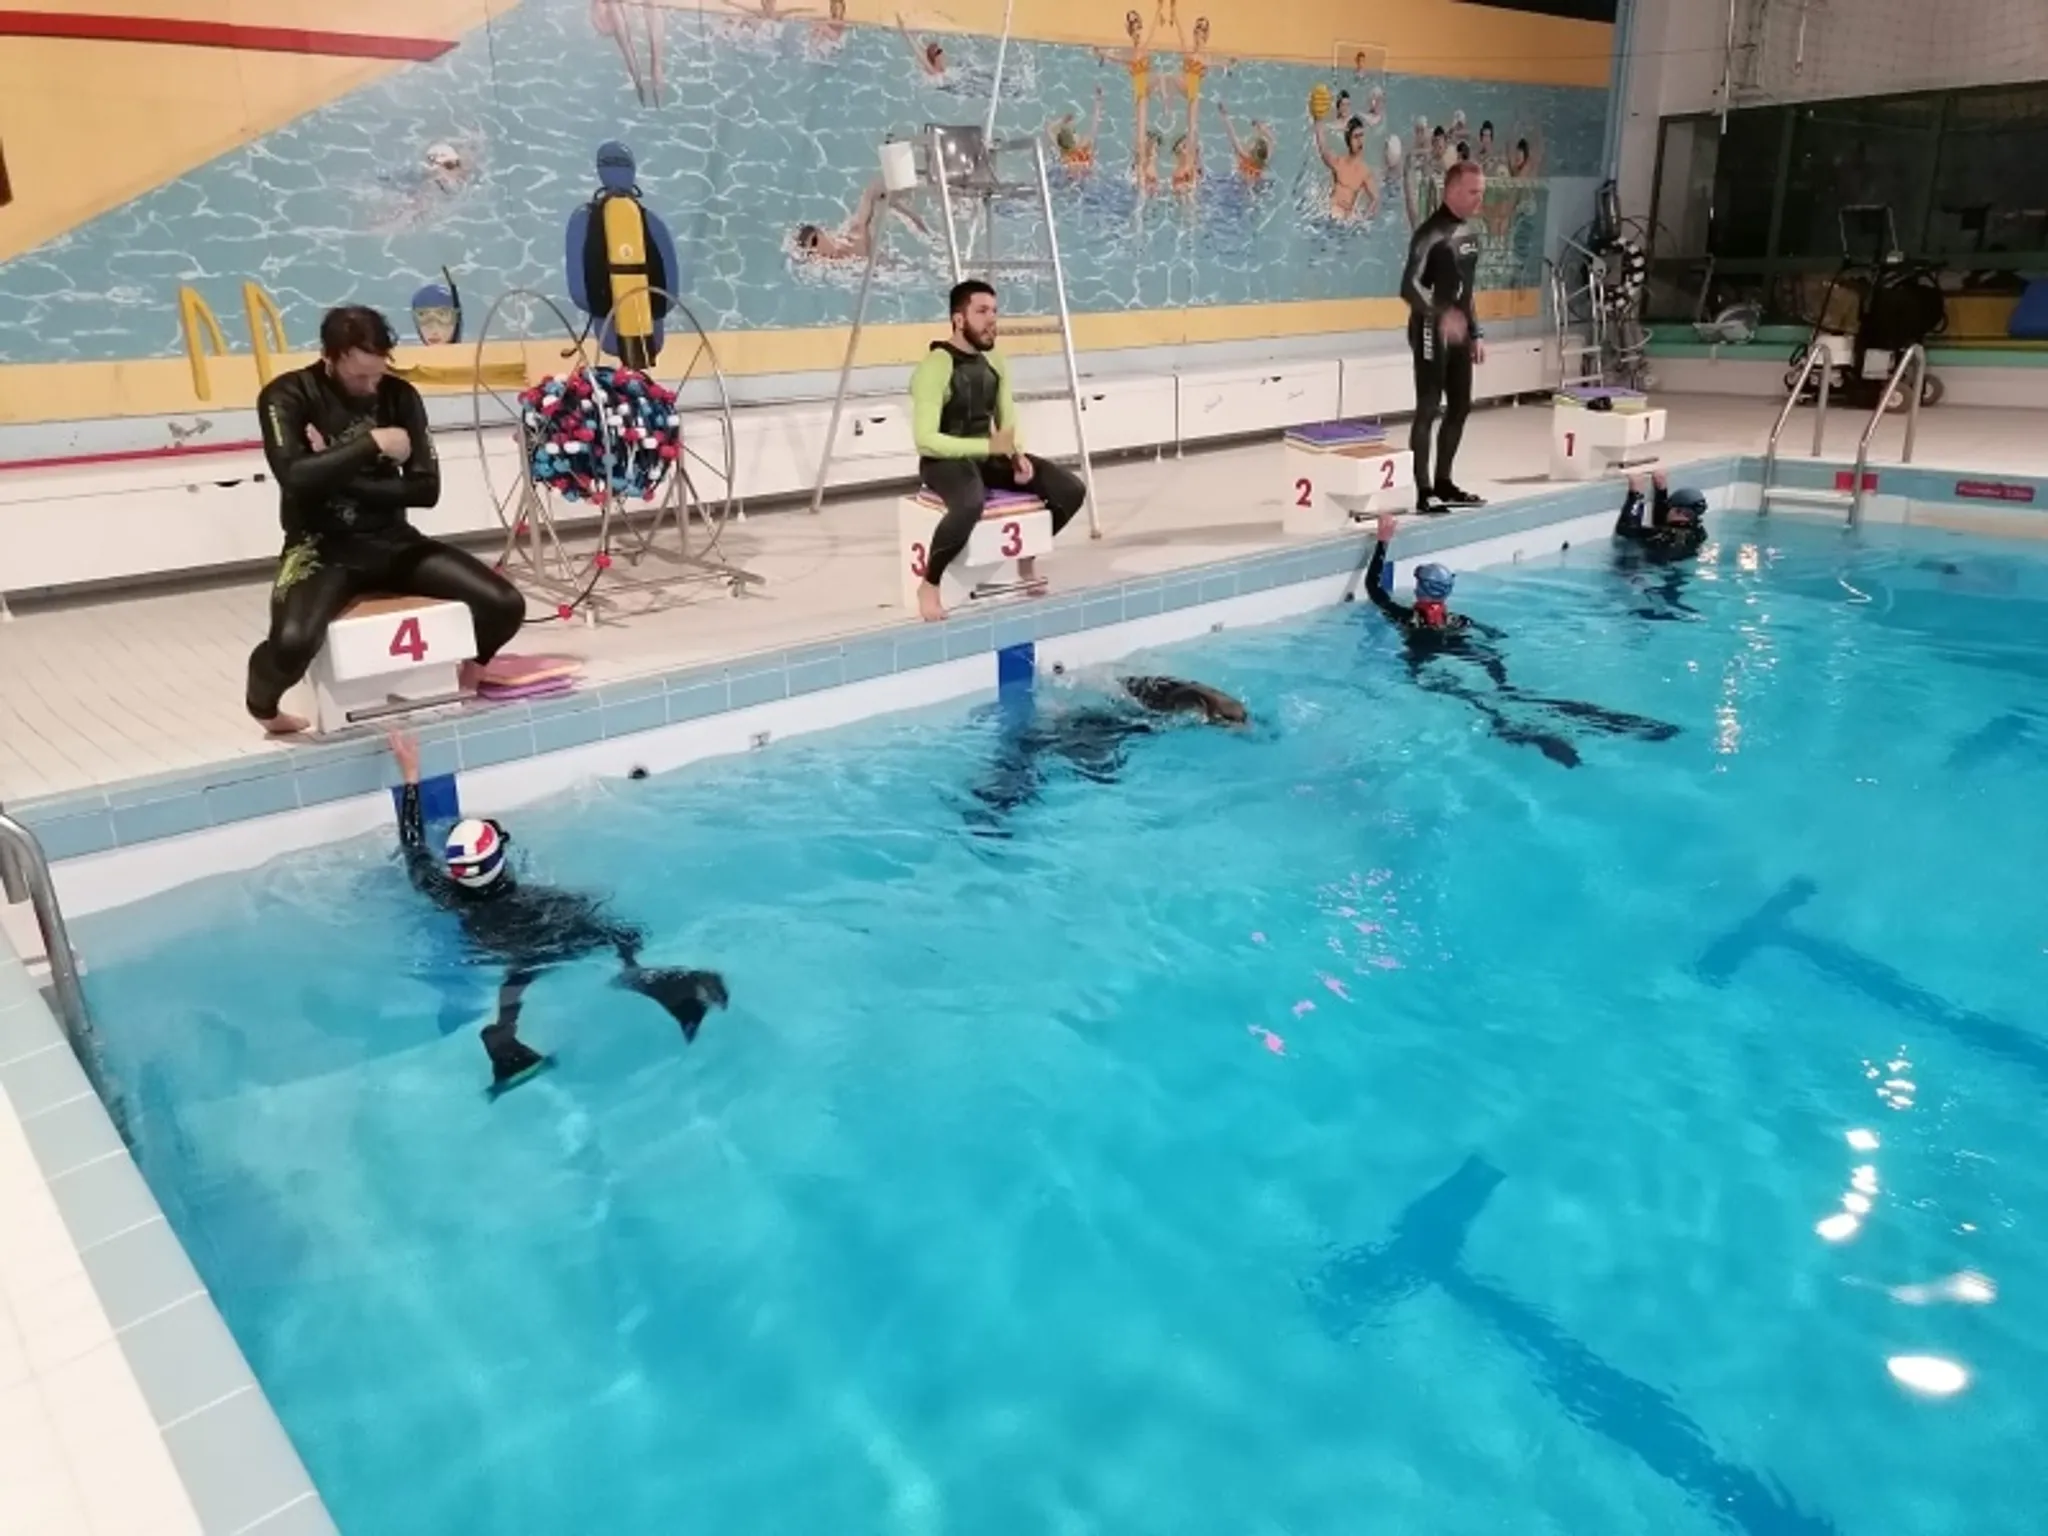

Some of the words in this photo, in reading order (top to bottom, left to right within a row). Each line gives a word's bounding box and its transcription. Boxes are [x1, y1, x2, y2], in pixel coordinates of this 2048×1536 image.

[1643, 416, 1651, 441] 1
[1564, 432, 1575, 457] 1
[1380, 459, 1395, 490] 2
[1295, 478, 1312, 507] 2
[1001, 521, 1023, 557] 3
[911, 542, 928, 577] 3
[389, 616, 429, 662] 4
